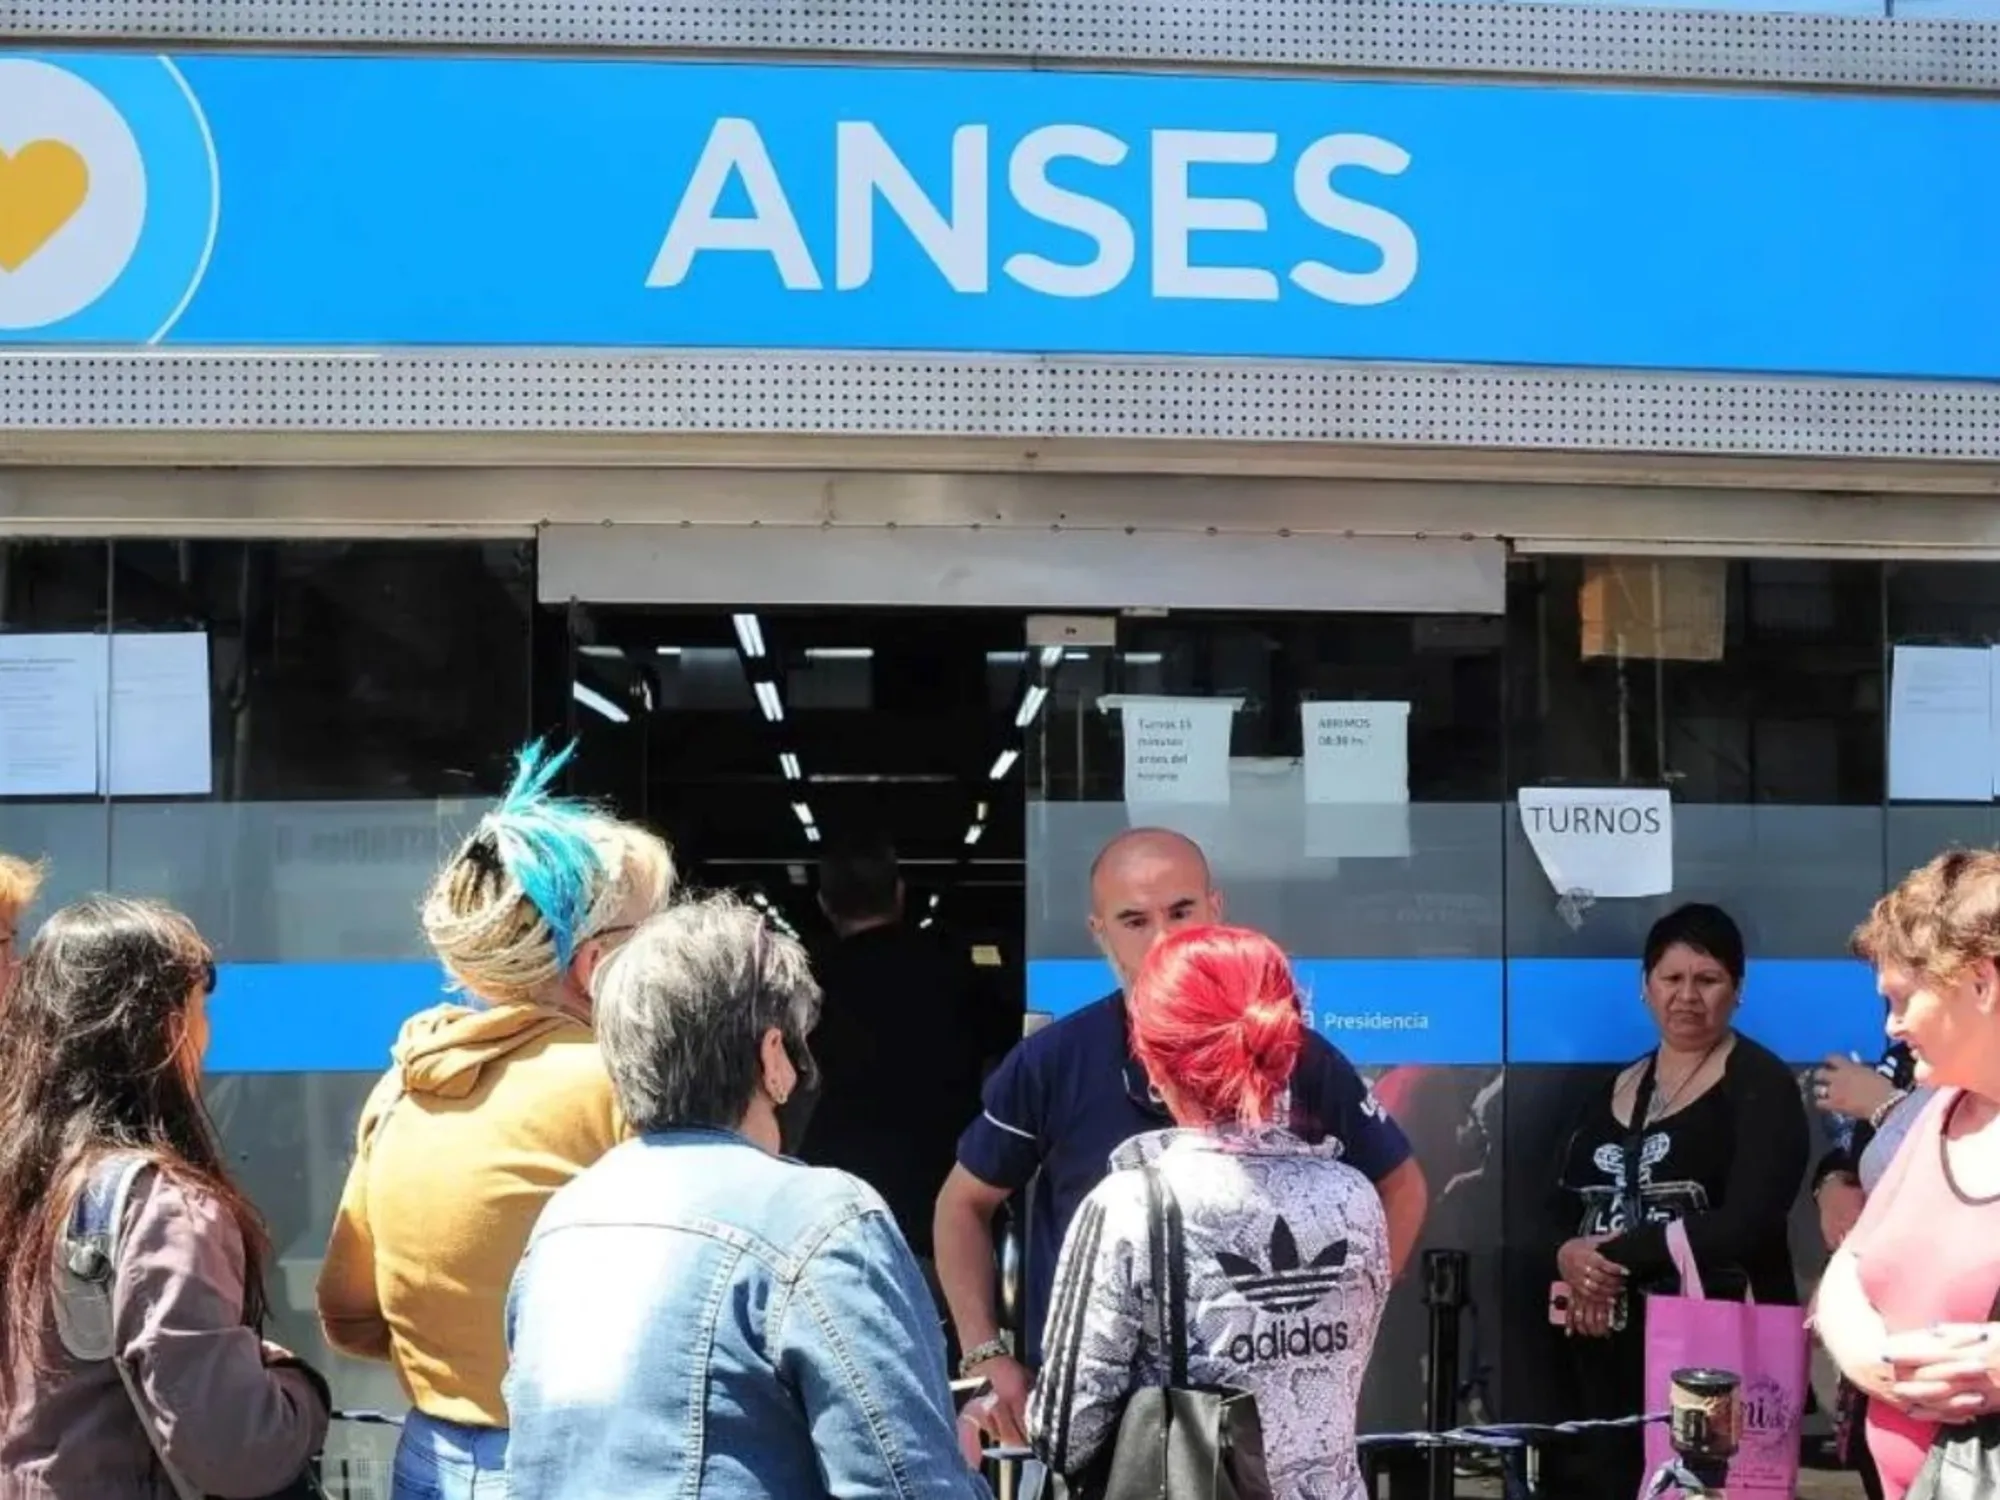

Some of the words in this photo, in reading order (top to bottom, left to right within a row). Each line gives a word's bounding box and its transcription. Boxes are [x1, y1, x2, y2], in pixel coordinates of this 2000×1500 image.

[644, 117, 1418, 305] ANSES
[1318, 718, 1371, 729] ABRIMOS
[1526, 806, 1661, 834] TURNOS
[1324, 1012, 1429, 1030] Presidencia
[1229, 1315, 1349, 1364] adidas
